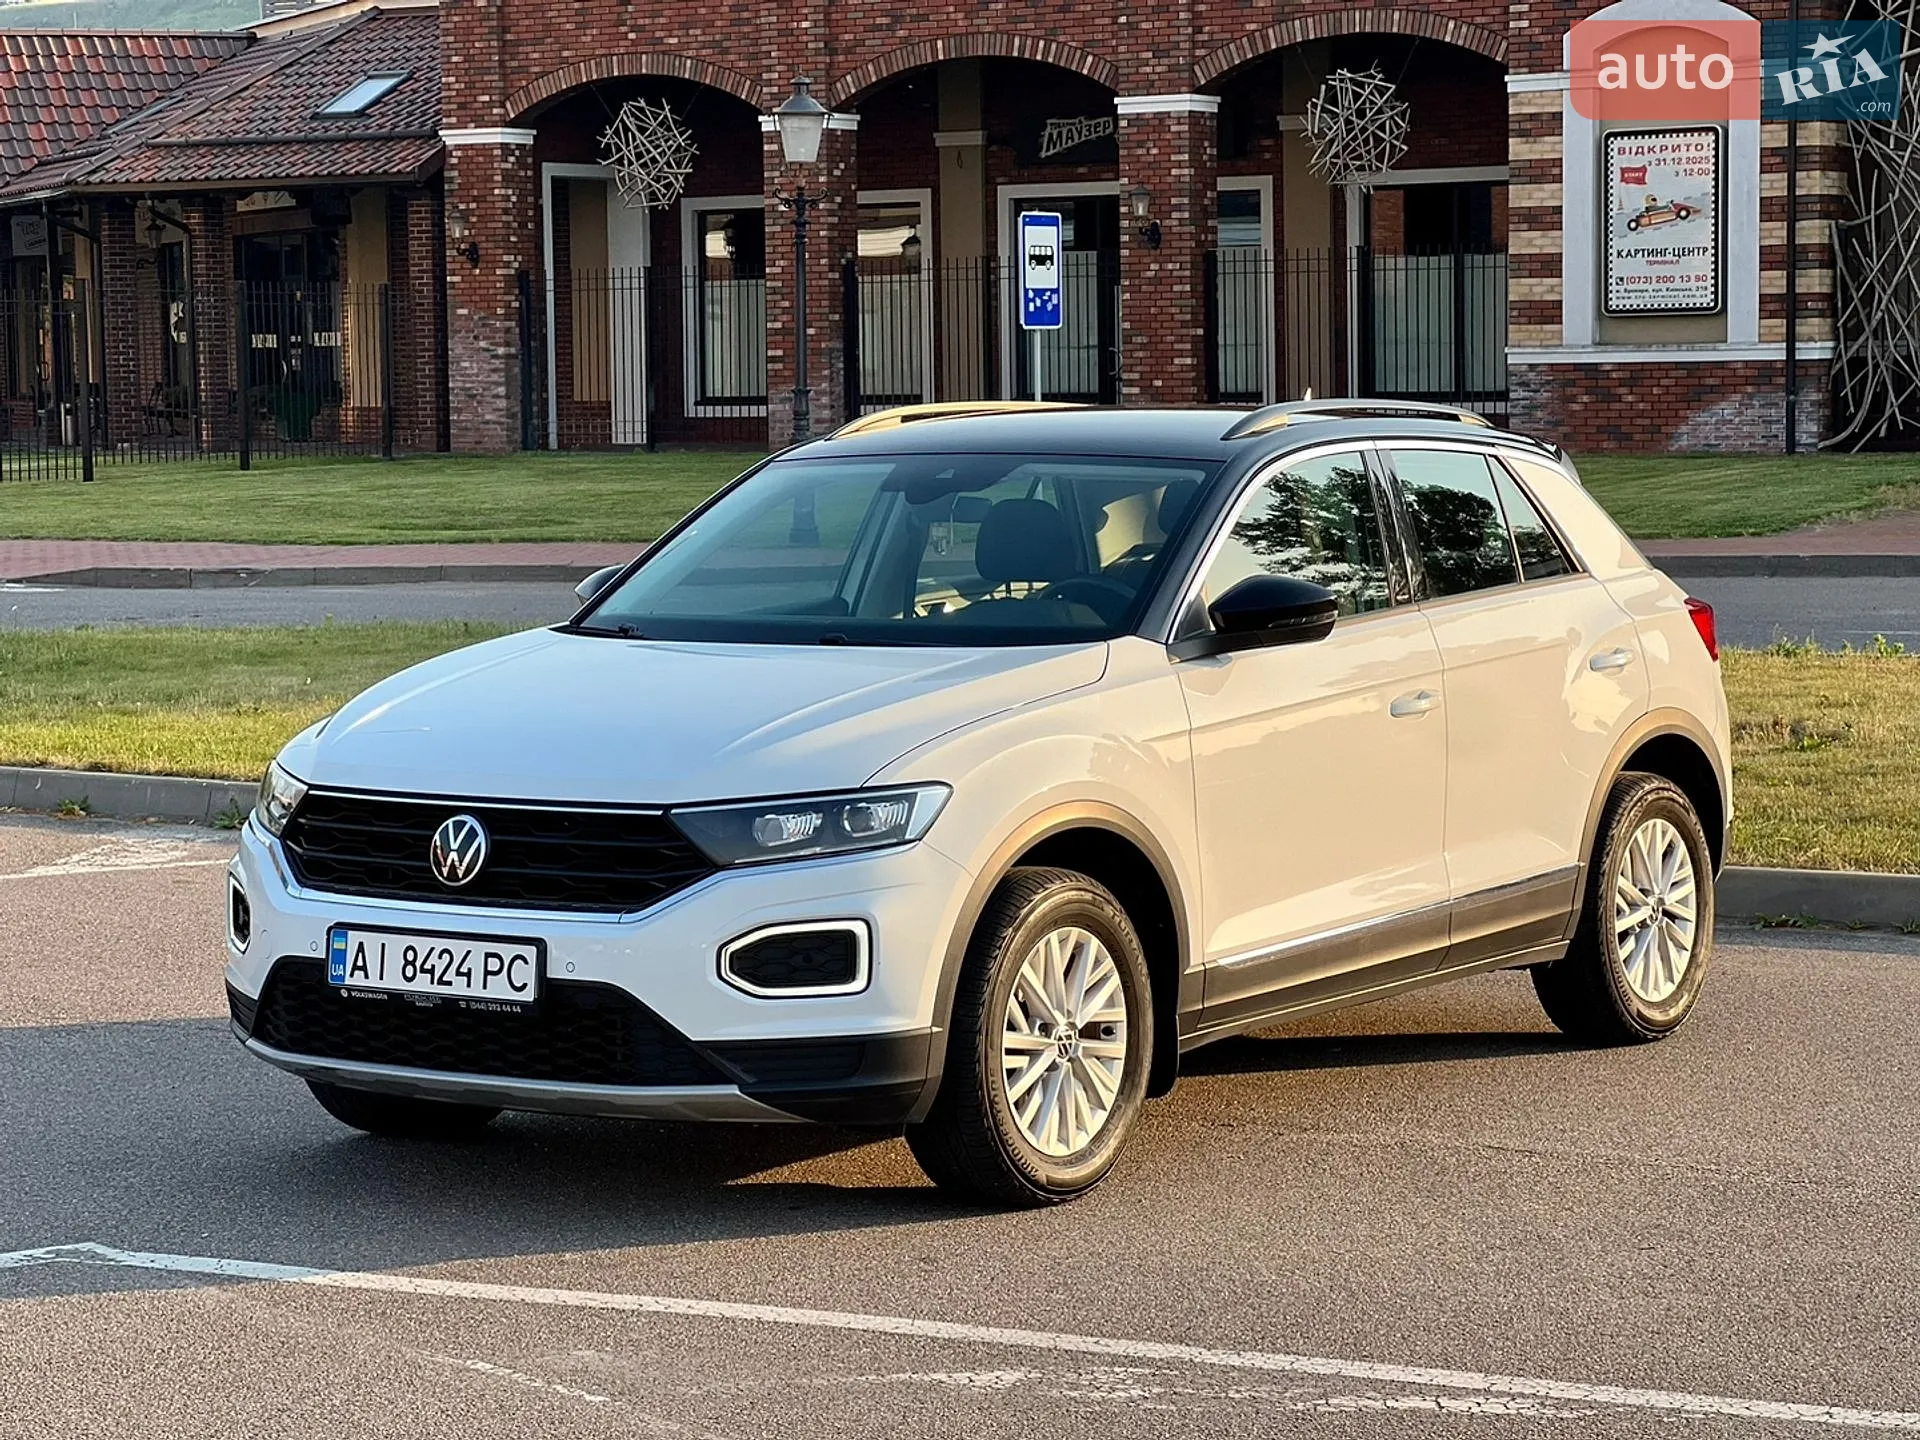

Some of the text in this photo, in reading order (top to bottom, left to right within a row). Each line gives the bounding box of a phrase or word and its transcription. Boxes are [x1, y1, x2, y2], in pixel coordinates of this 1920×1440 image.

[1617, 142, 1710, 156] ВІДКРИТО!
[1655, 156, 1710, 166] 31.12.2025
[1616, 247, 1709, 259] КАРТИНГ-ЦЕНТР
[1626, 276, 1652, 285] (073)
[1655, 275, 1675, 284] 200
[1680, 275, 1691, 283] 13
[331, 941, 530, 993] UA AI 8424 PC
